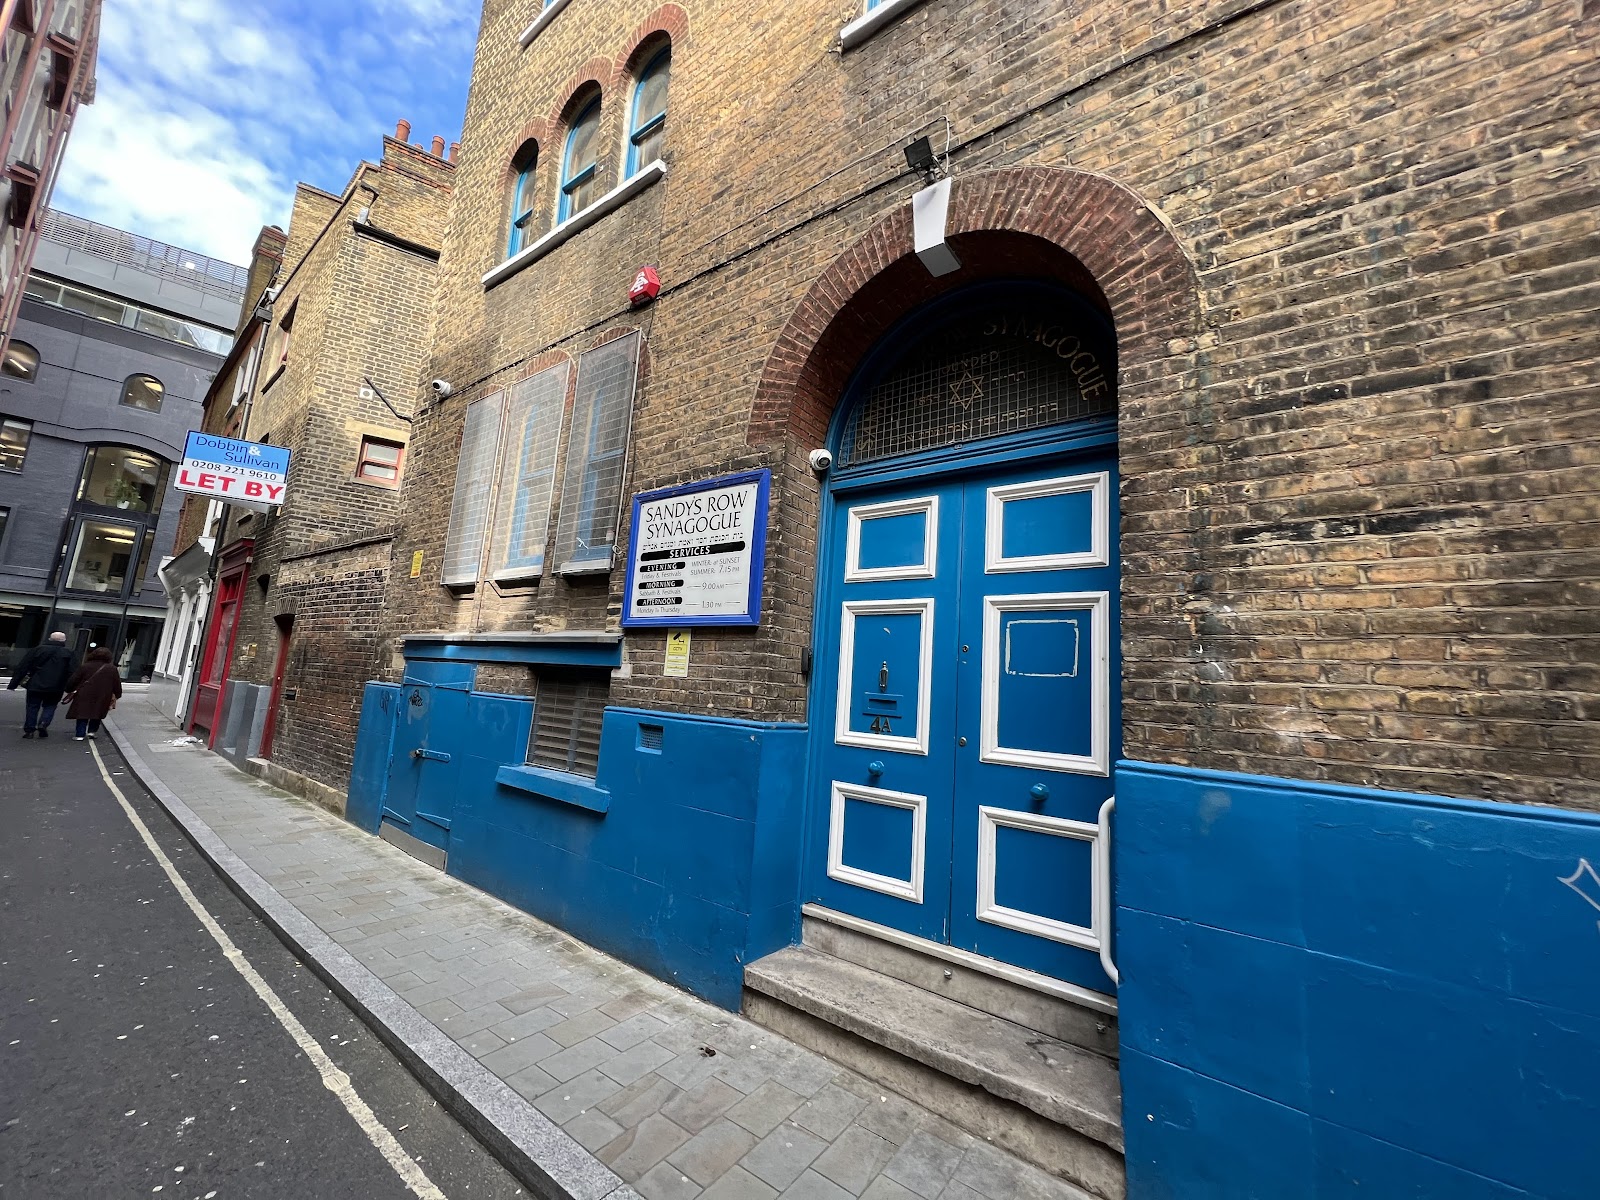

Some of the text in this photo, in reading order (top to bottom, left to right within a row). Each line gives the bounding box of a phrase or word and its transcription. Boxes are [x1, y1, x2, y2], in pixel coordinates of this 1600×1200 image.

[982, 314, 1110, 402] SYNAGOGUE
[196, 436, 248, 454] Dobbin
[224, 451, 279, 470] Sullivan
[191, 460, 277, 481] 0208 221 9610
[179, 470, 284, 500] LET BY
[707, 490, 748, 513] ROW
[646, 511, 741, 540] SYNAGOGUE
[669, 545, 711, 559] SERVICES
[719, 557, 741, 565] SUNSET
[641, 571, 654, 580] Friday
[646, 562, 678, 572] EVENING
[639, 589, 656, 597] Sabbath
[645, 580, 676, 589] MORNING
[642, 597, 676, 606] AFTERNOON
[869, 716, 893, 735] 4A
